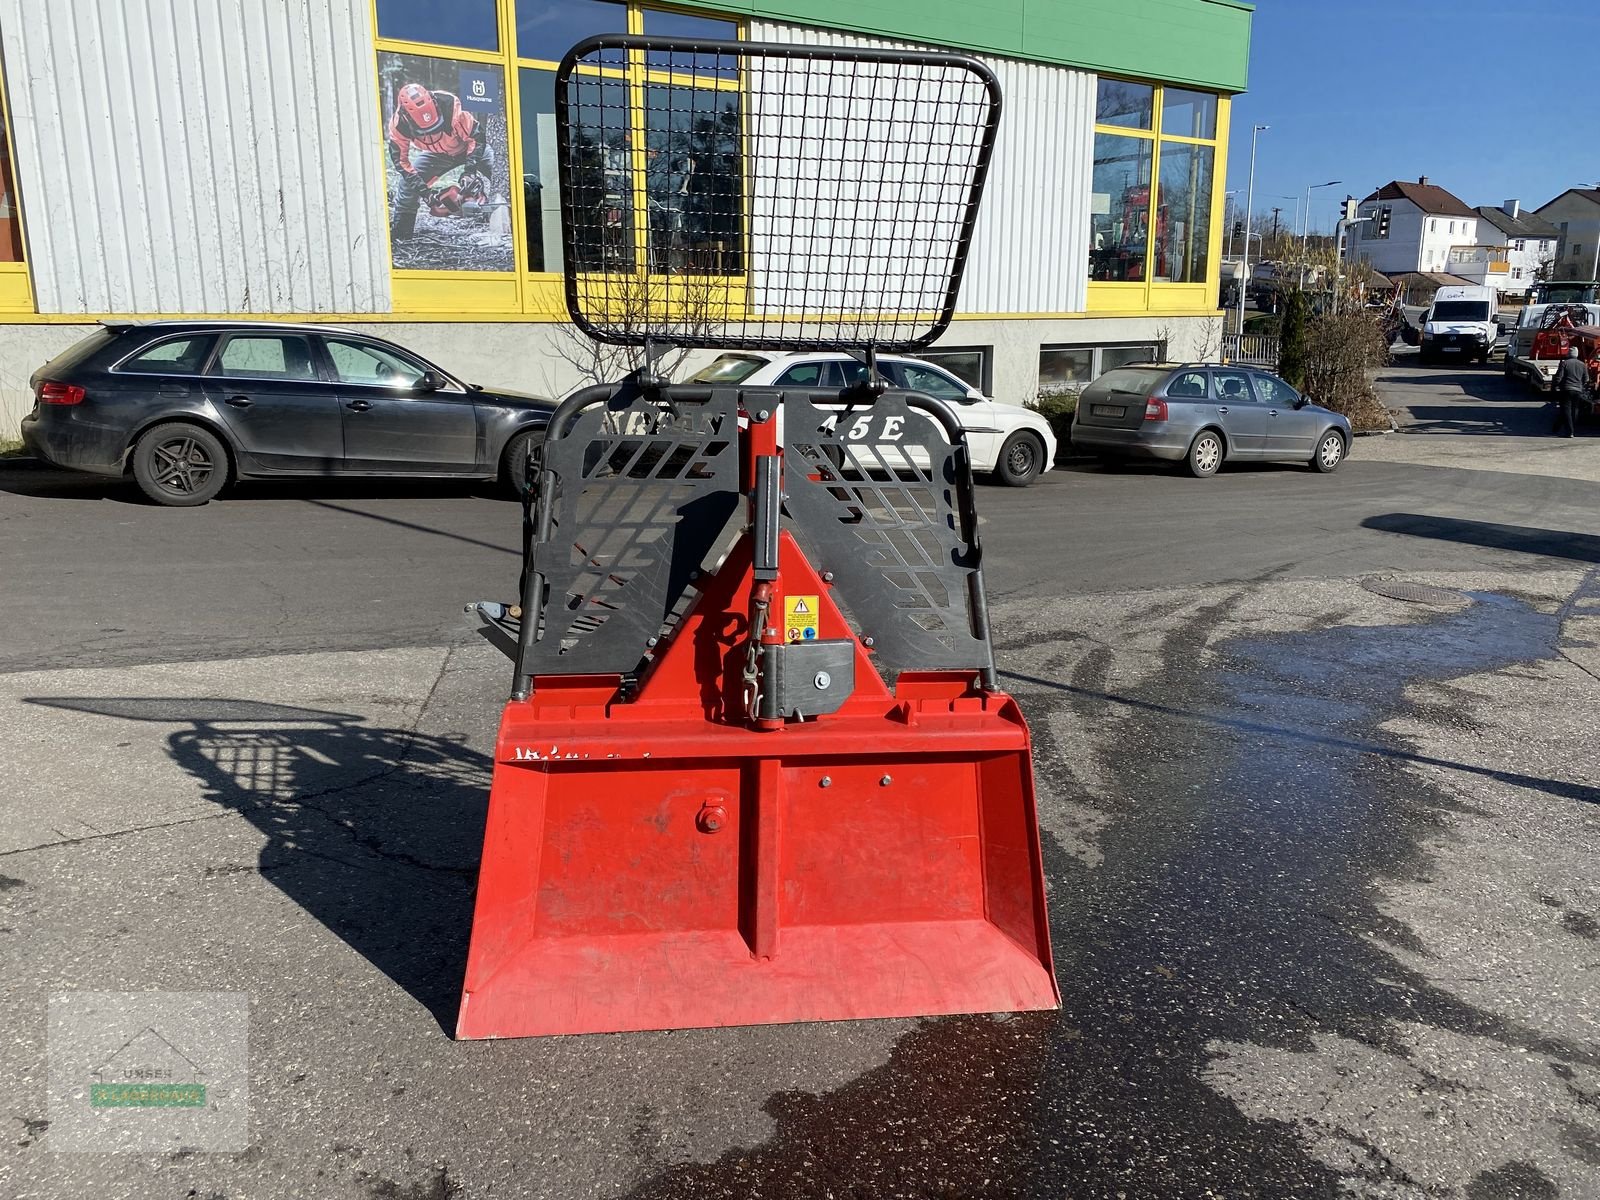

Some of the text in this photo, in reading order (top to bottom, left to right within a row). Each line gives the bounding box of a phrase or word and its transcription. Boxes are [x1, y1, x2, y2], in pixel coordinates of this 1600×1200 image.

[466, 95, 493, 103] Husqvarna
[816, 415, 874, 442] 4.5
[878, 416, 905, 441] E
